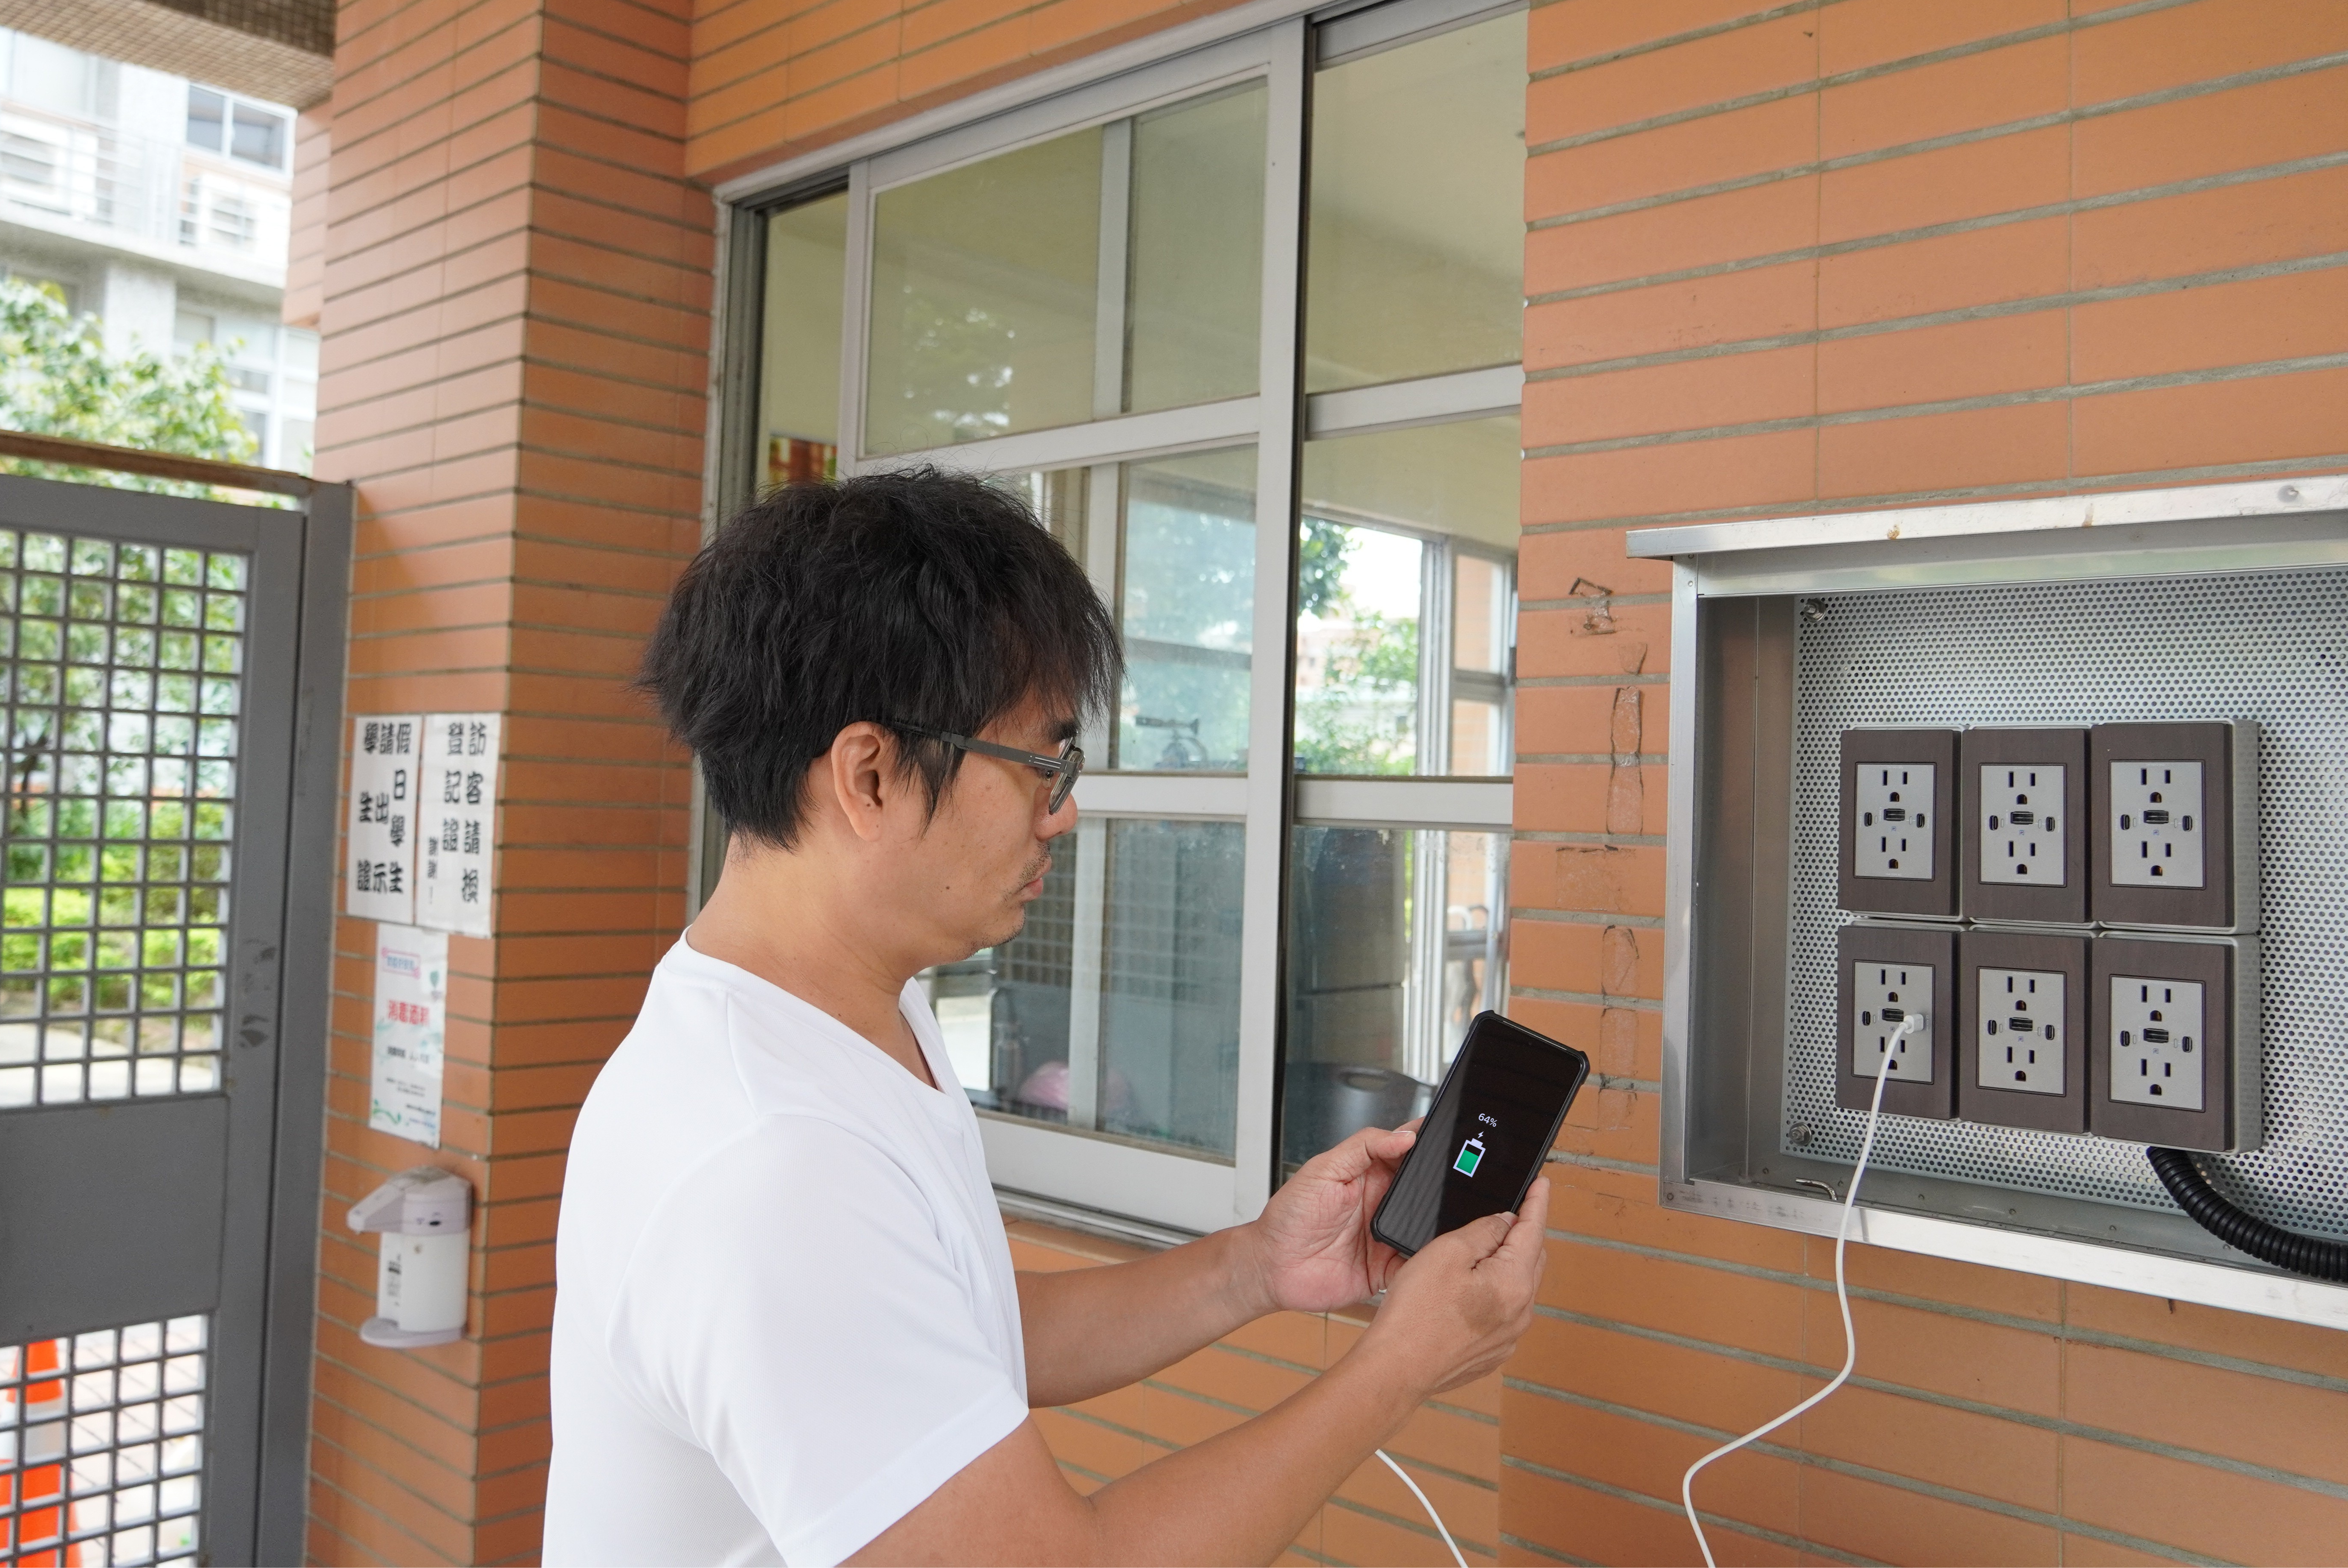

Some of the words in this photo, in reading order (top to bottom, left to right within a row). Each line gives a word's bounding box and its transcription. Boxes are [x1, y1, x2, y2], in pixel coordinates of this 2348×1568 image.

[358, 723, 379, 893] 學生證
[373, 723, 394, 894] 請出示
[390, 723, 412, 894] 假日學生
[1478, 1113, 1498, 1127] 64%
